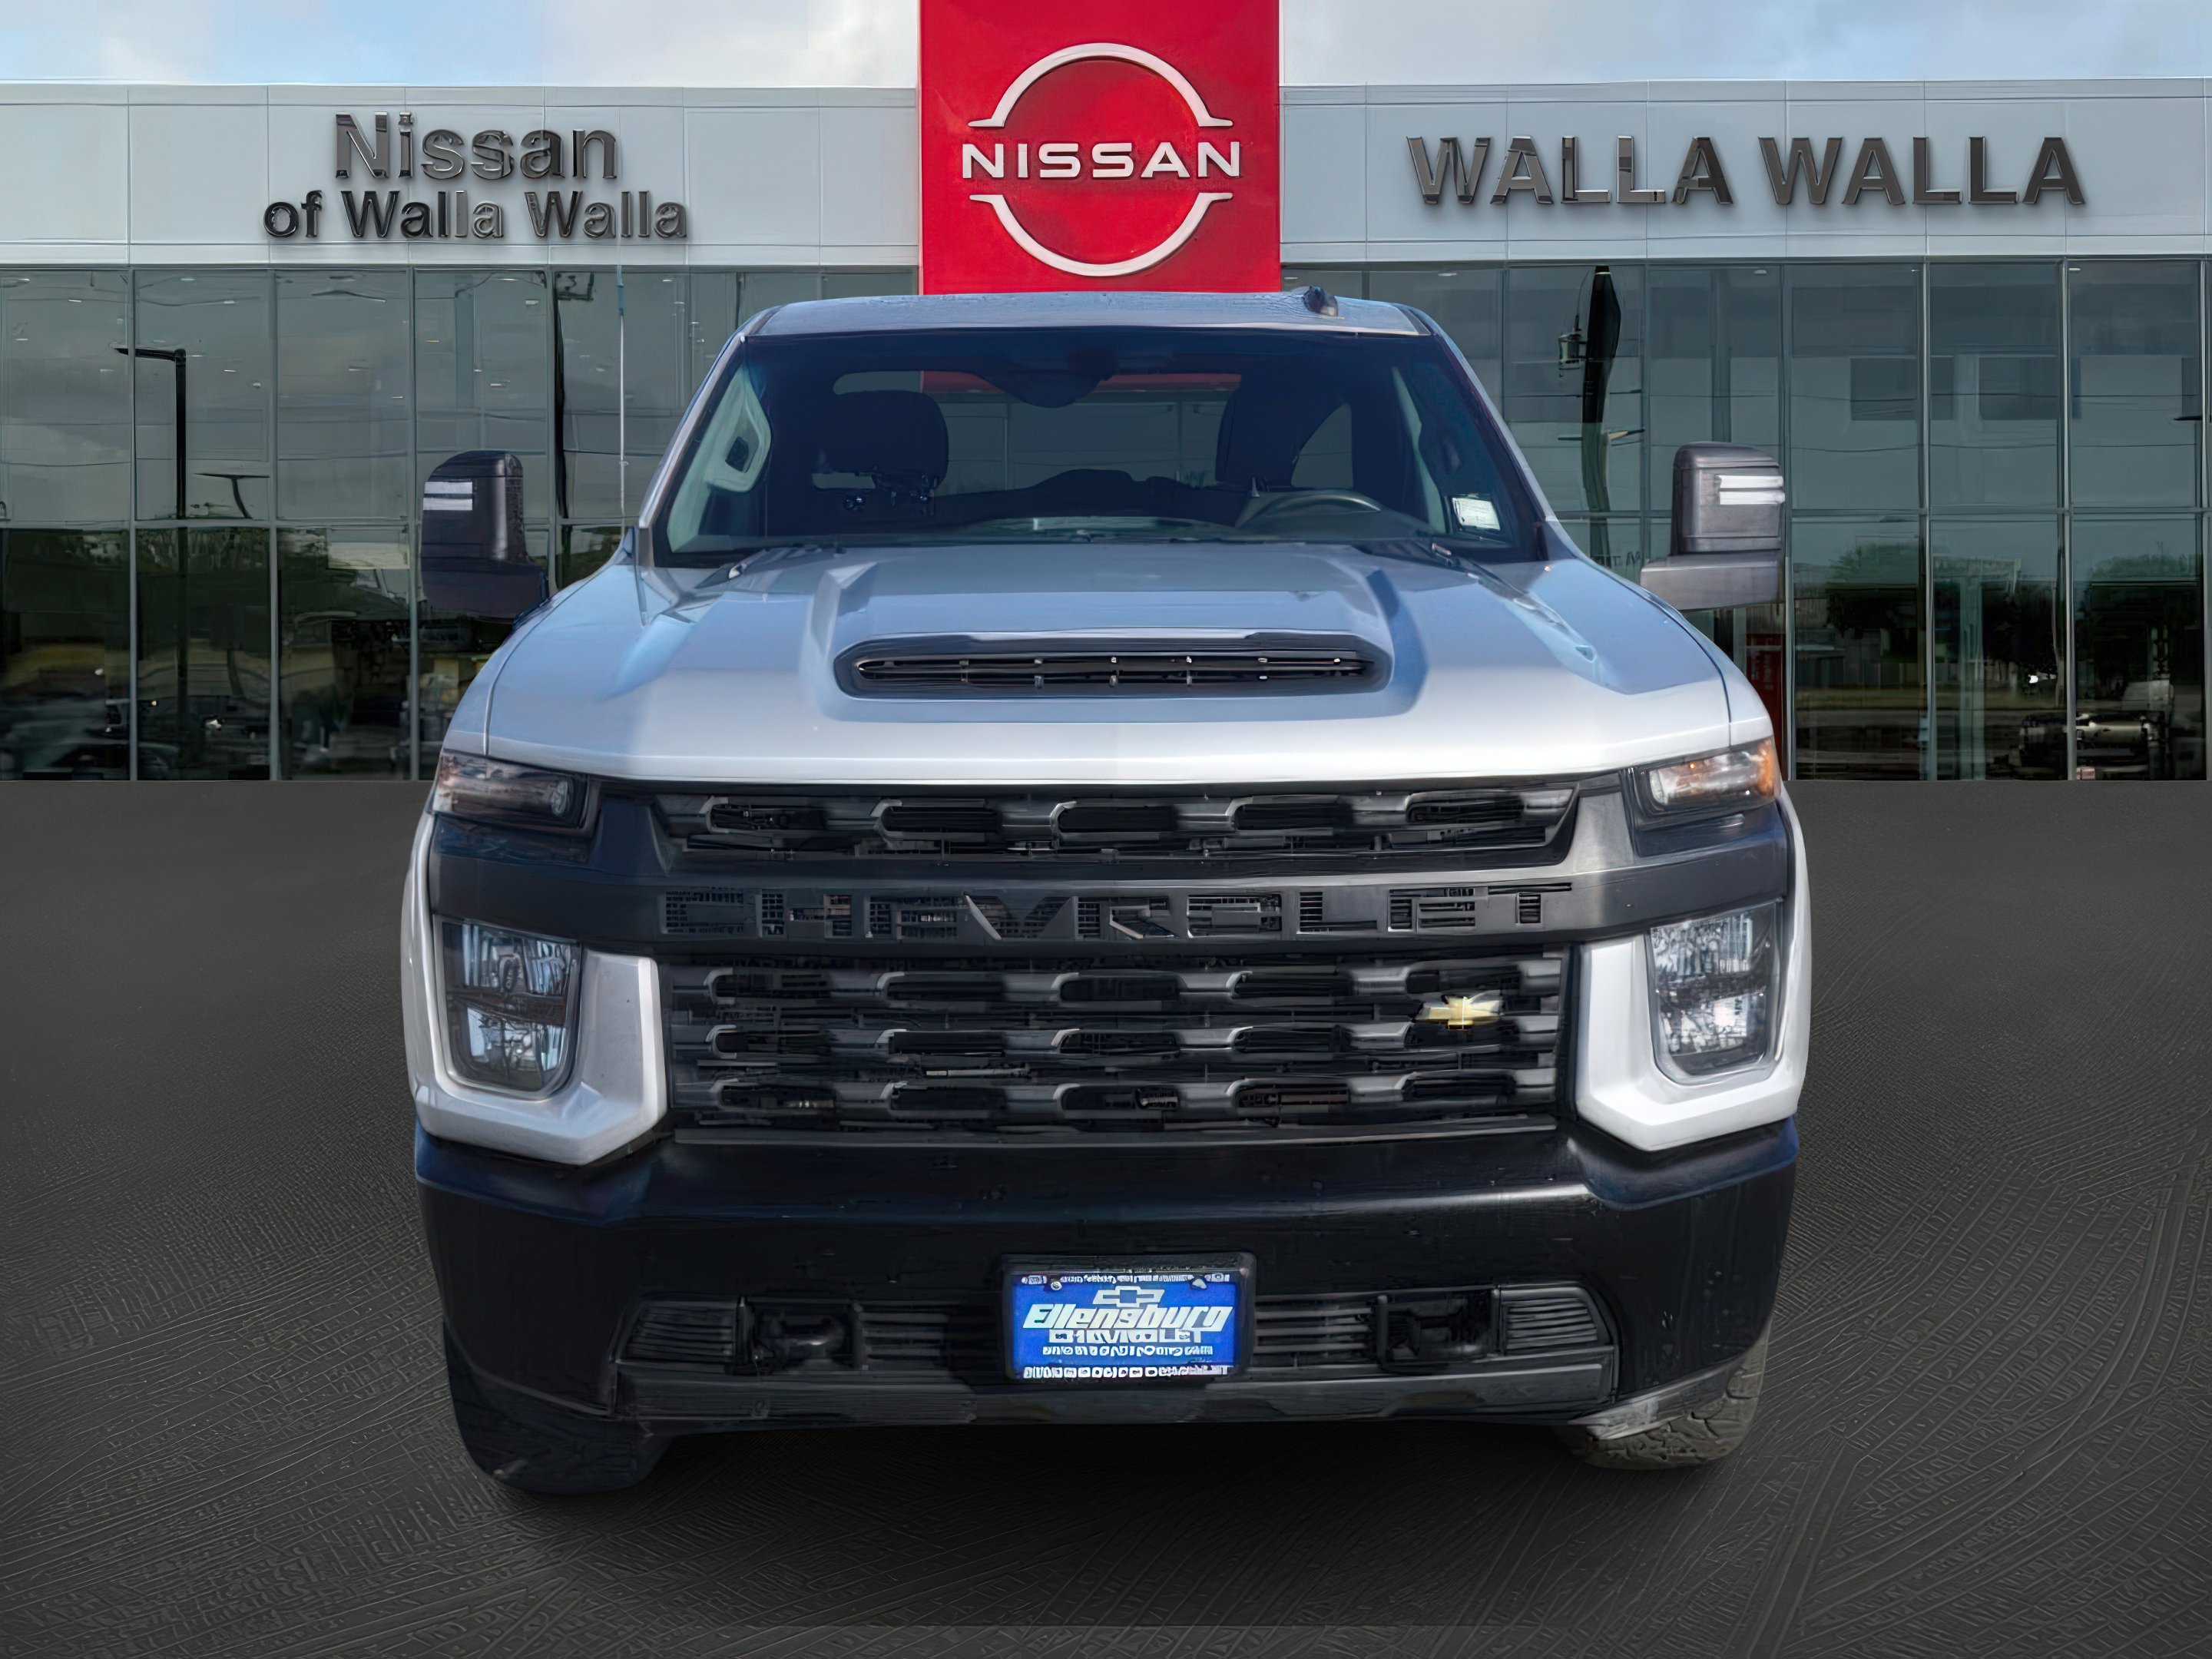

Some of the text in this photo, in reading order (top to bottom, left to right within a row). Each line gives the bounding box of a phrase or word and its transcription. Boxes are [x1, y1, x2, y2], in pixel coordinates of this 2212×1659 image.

[335, 111, 618, 180] Nissan
[962, 141, 1240, 179] NISSAN
[1406, 135, 2086, 205] WALLA WALLA
[263, 189, 688, 239] of Walla Walla
[655, 882, 1574, 941] CHEVROLET
[1022, 1303, 1233, 1333] Ellensburg
